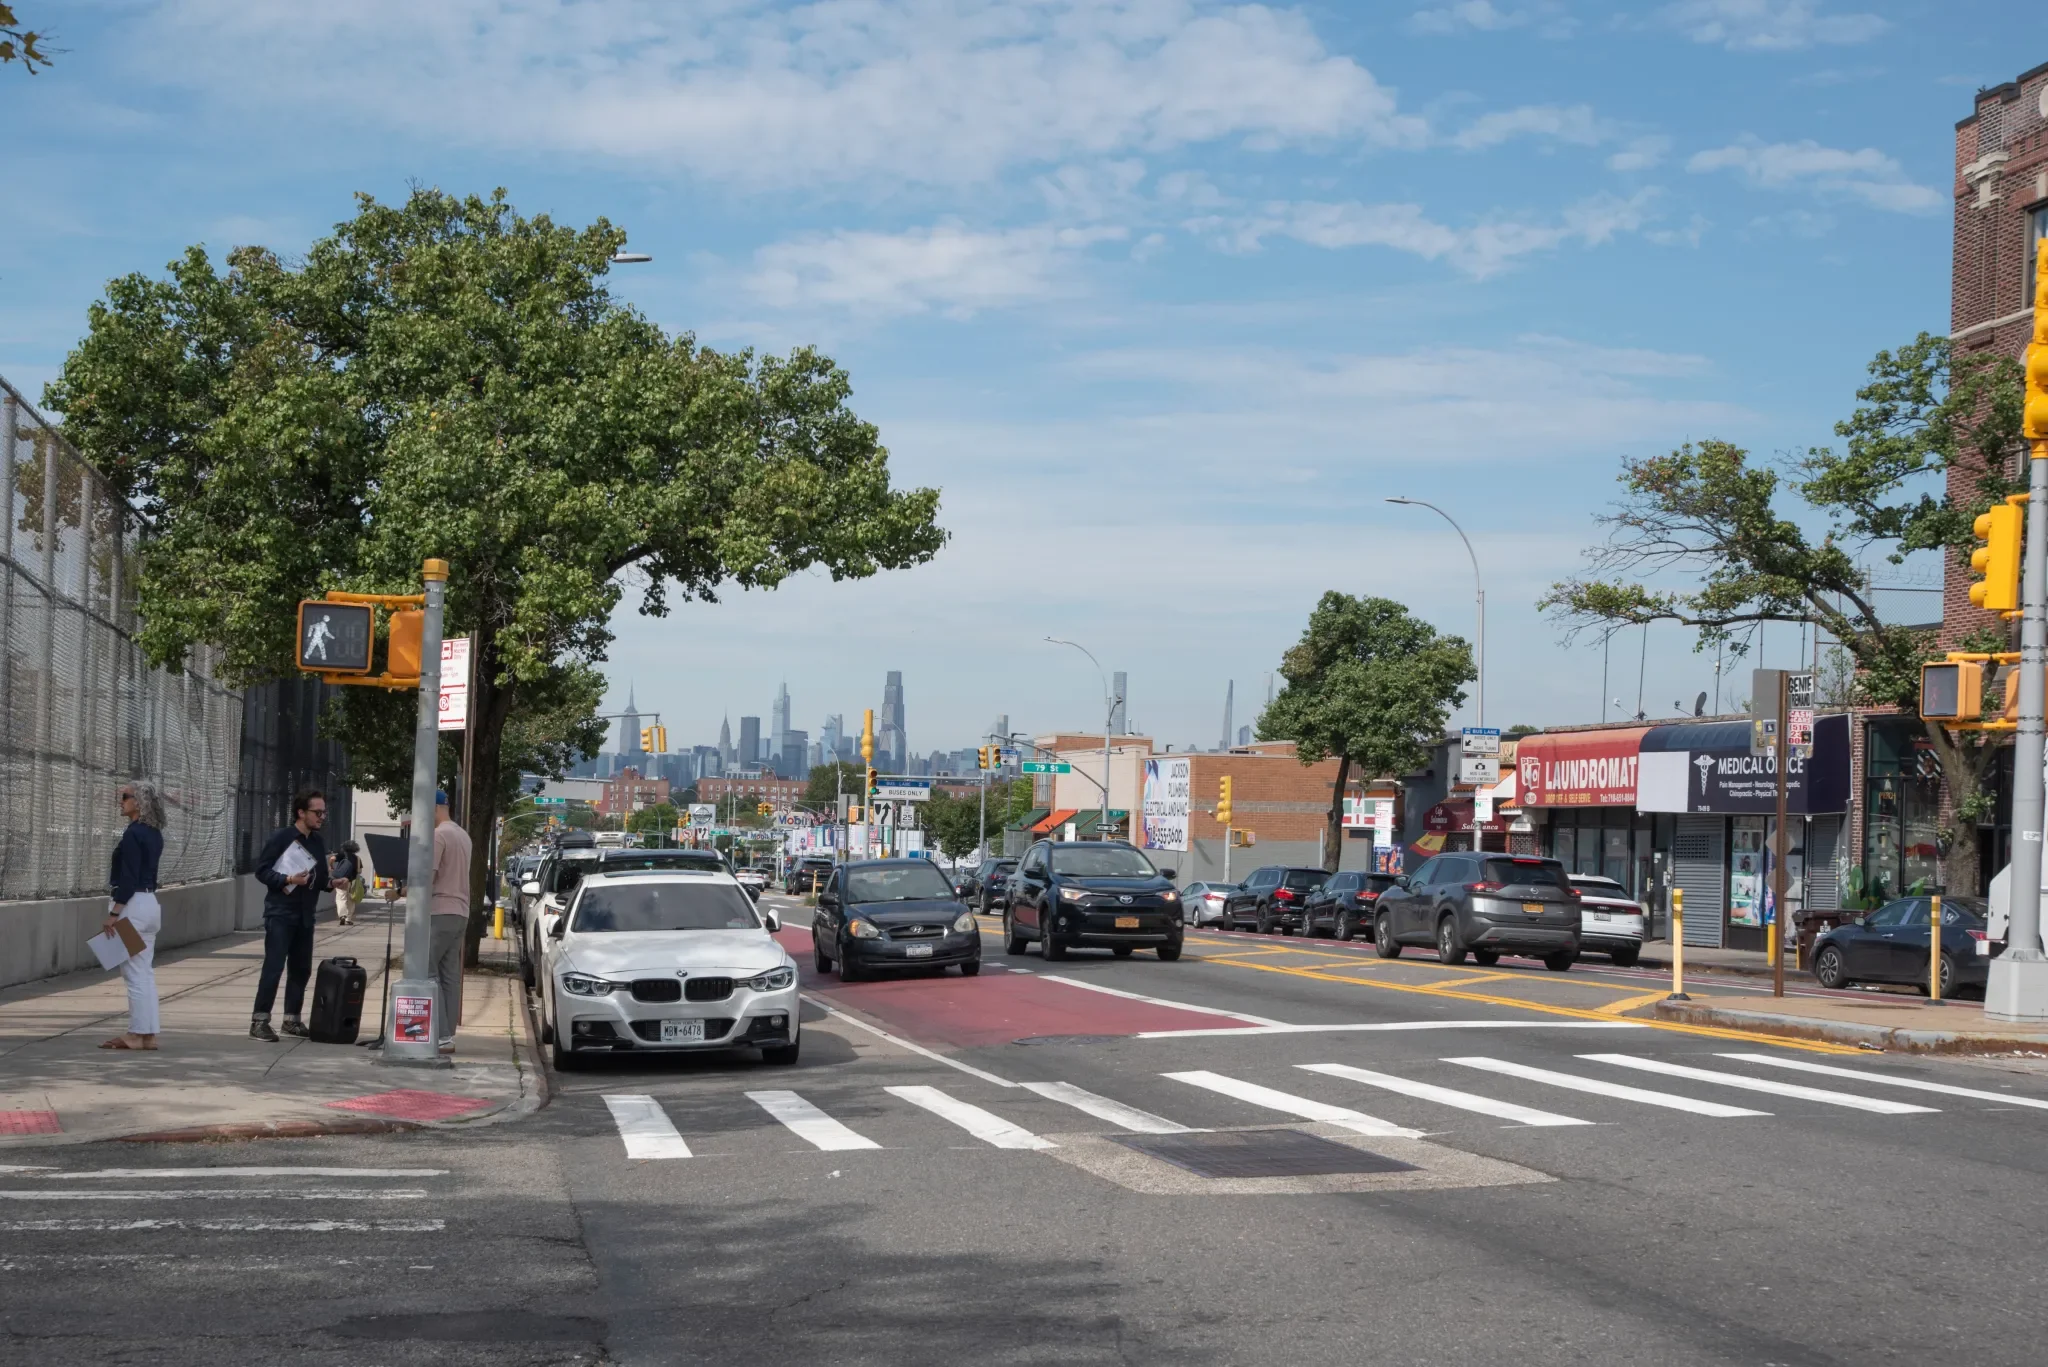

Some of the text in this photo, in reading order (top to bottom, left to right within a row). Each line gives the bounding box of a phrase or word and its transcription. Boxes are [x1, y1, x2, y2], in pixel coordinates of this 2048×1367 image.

[1788, 676, 1813, 693] GENIE
[1171, 763, 1188, 779] JACKSON
[1717, 756, 1804, 774] MEDICAL OICE
[1545, 756, 1637, 790] LAUNDROMAT
[1168, 782, 1188, 797] PLUMBING
[1728, 781, 1753, 789] Management
[1755, 781, 1775, 789] Neurology
[1545, 793, 1555, 803] DROP
[1556, 793, 1564, 803] OFF
[1729, 790, 1753, 798] Chiropractic
[1755, 790, 1772, 798] Physical
[1145, 801, 1167, 816] ELECTRICAL
[778, 815, 808, 826] Mobil
[751, 832, 769, 840] Mobil
